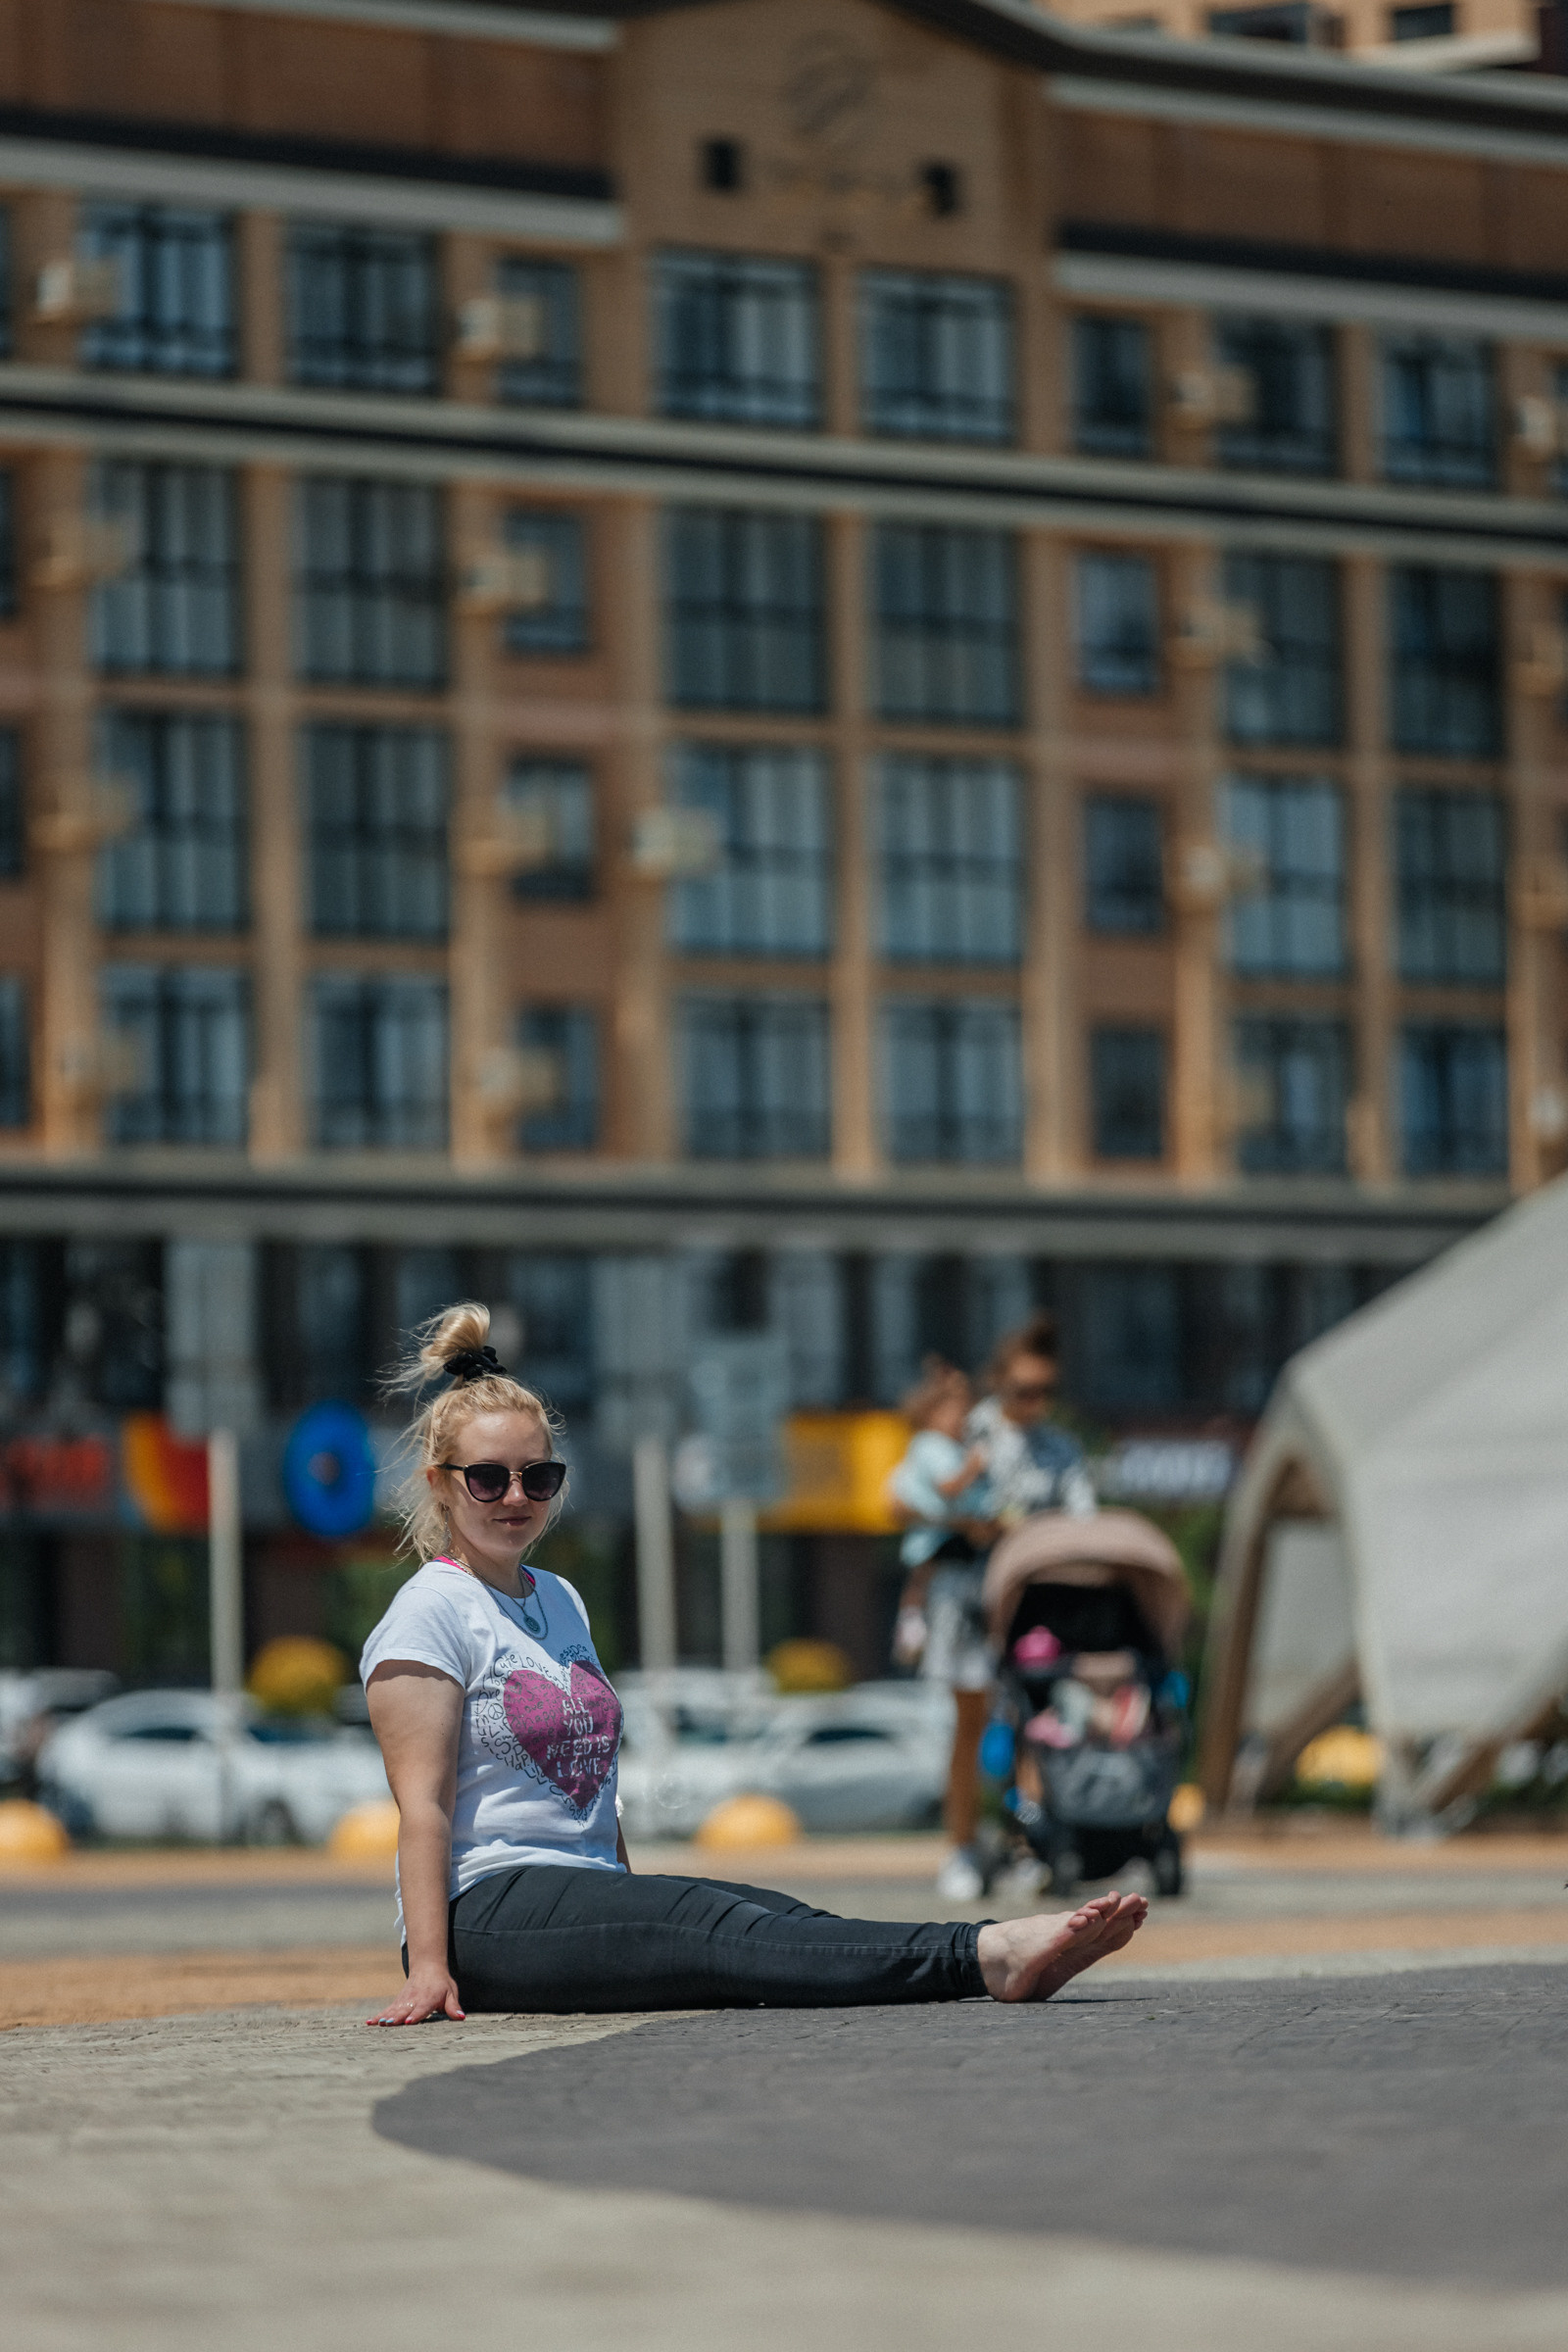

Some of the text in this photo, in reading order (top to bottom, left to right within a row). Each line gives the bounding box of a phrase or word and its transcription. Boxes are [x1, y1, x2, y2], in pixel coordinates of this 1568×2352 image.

[562, 1696, 589, 1716] ALL
[563, 1716, 594, 1737] YOU
[546, 1735, 611, 1760] NEED IS
[556, 1757, 601, 1778] LOVE
